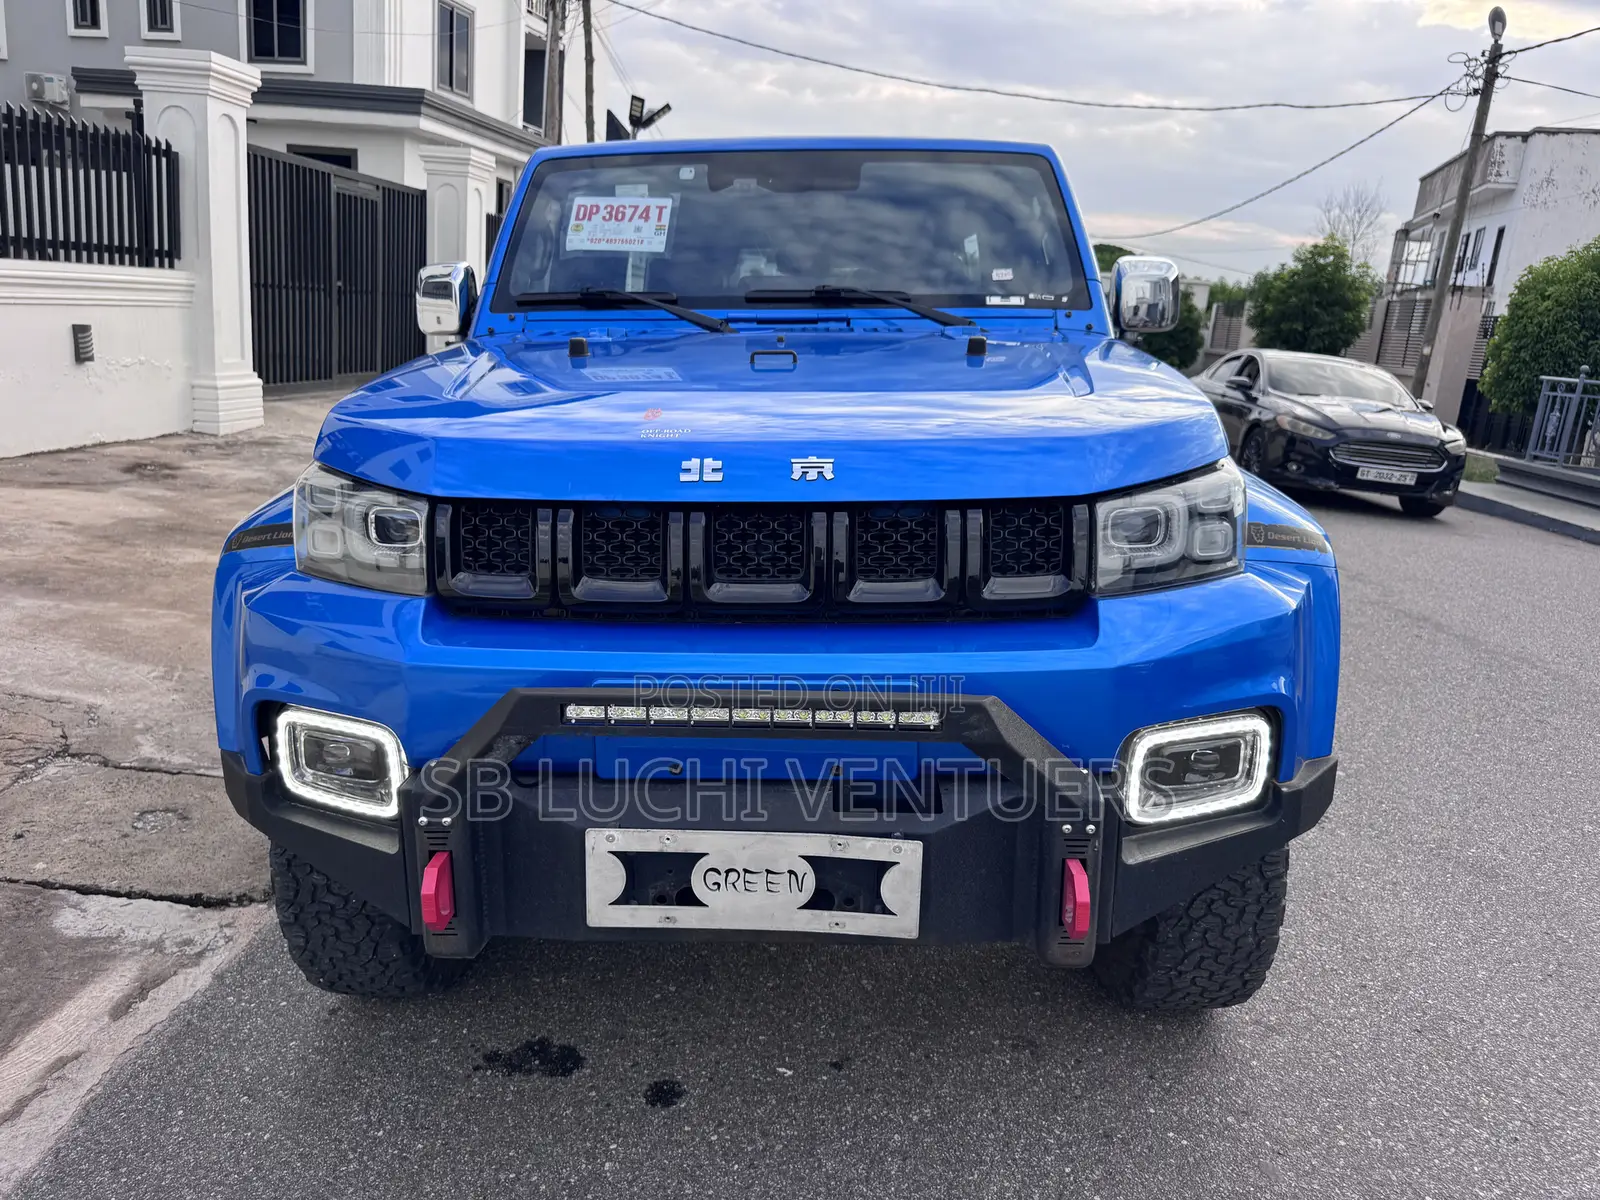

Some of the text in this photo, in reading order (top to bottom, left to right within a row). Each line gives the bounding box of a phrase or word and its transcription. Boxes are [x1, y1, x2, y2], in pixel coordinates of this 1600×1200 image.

[575, 205, 667, 222] DP 3674 T
[242, 534, 271, 543] Desert
[1267, 531, 1301, 543] Desert
[703, 866, 808, 894] GREEN
